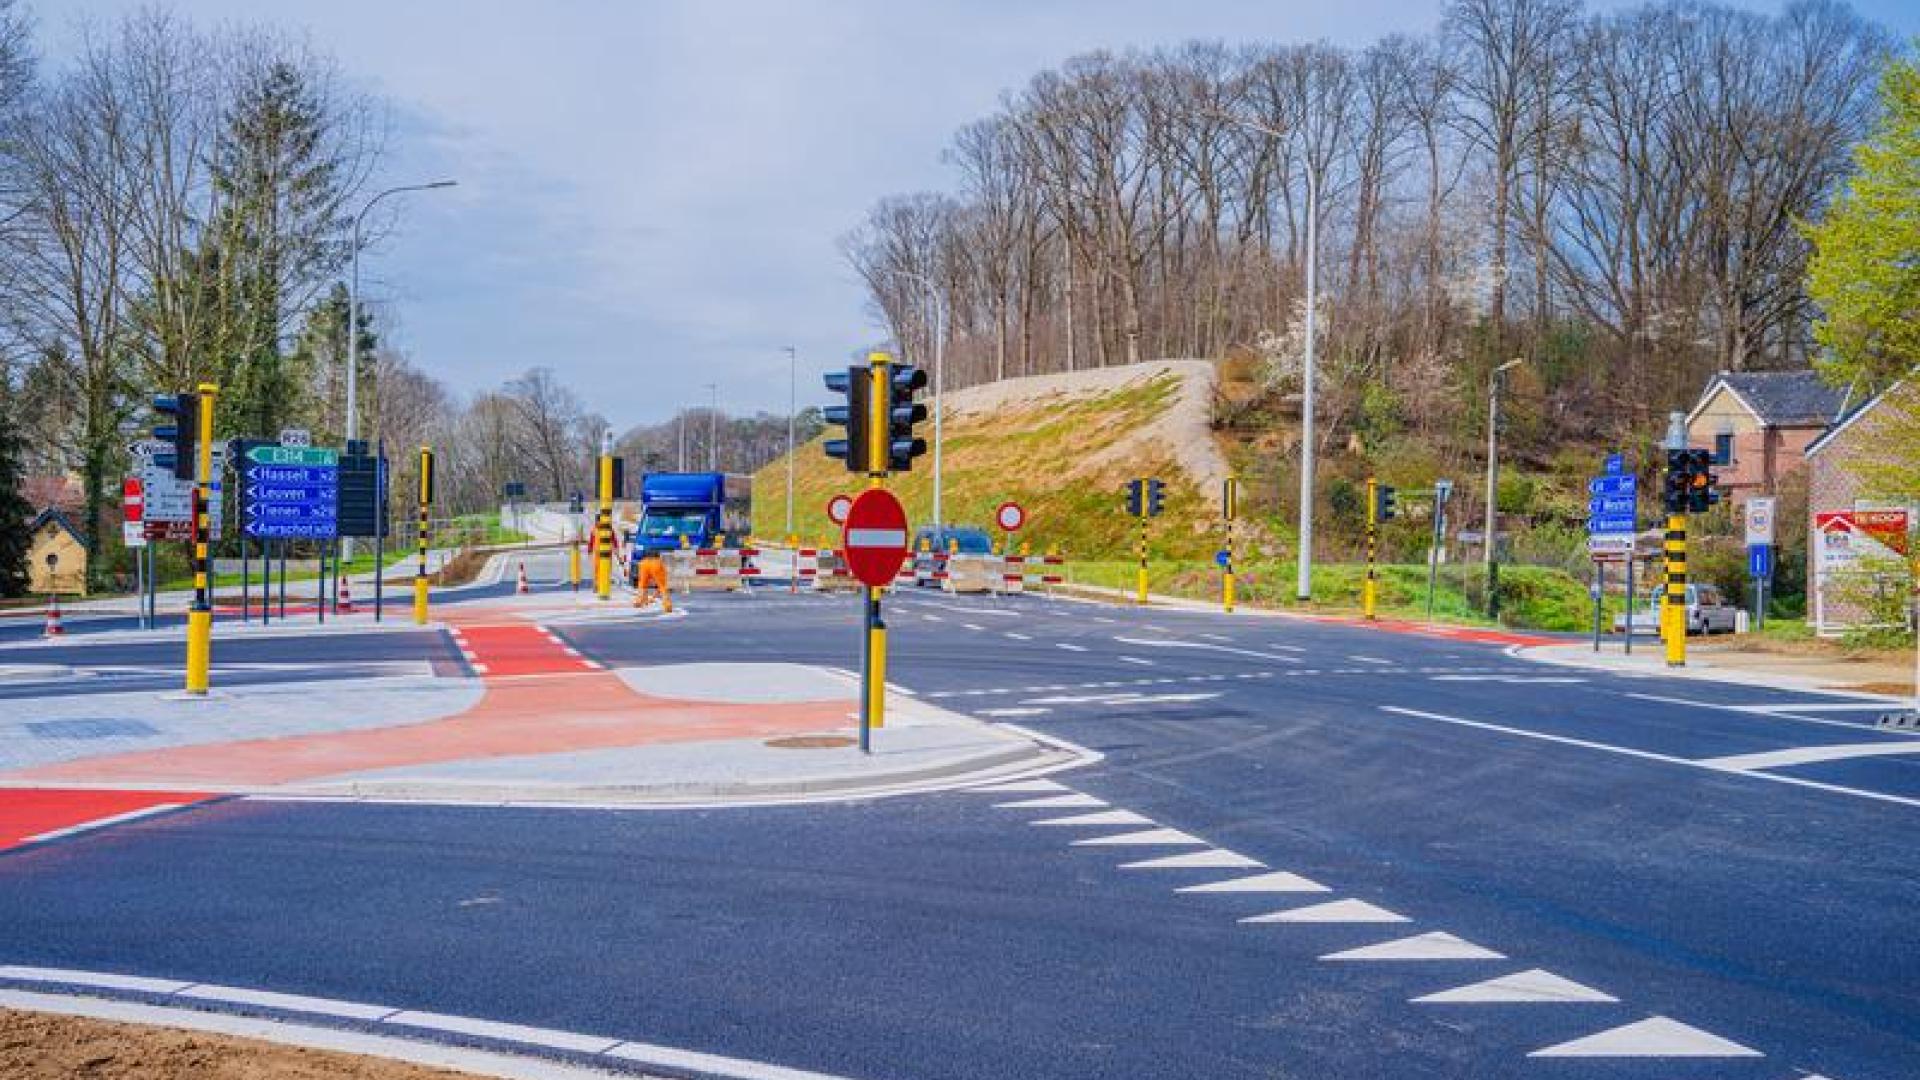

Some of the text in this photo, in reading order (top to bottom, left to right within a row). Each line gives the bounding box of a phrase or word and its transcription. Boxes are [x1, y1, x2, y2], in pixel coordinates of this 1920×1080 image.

[273, 448, 303, 462] E314
[262, 467, 308, 481] Hasselt
[261, 485, 306, 499] Leuven
[261, 504, 300, 517] Tienen
